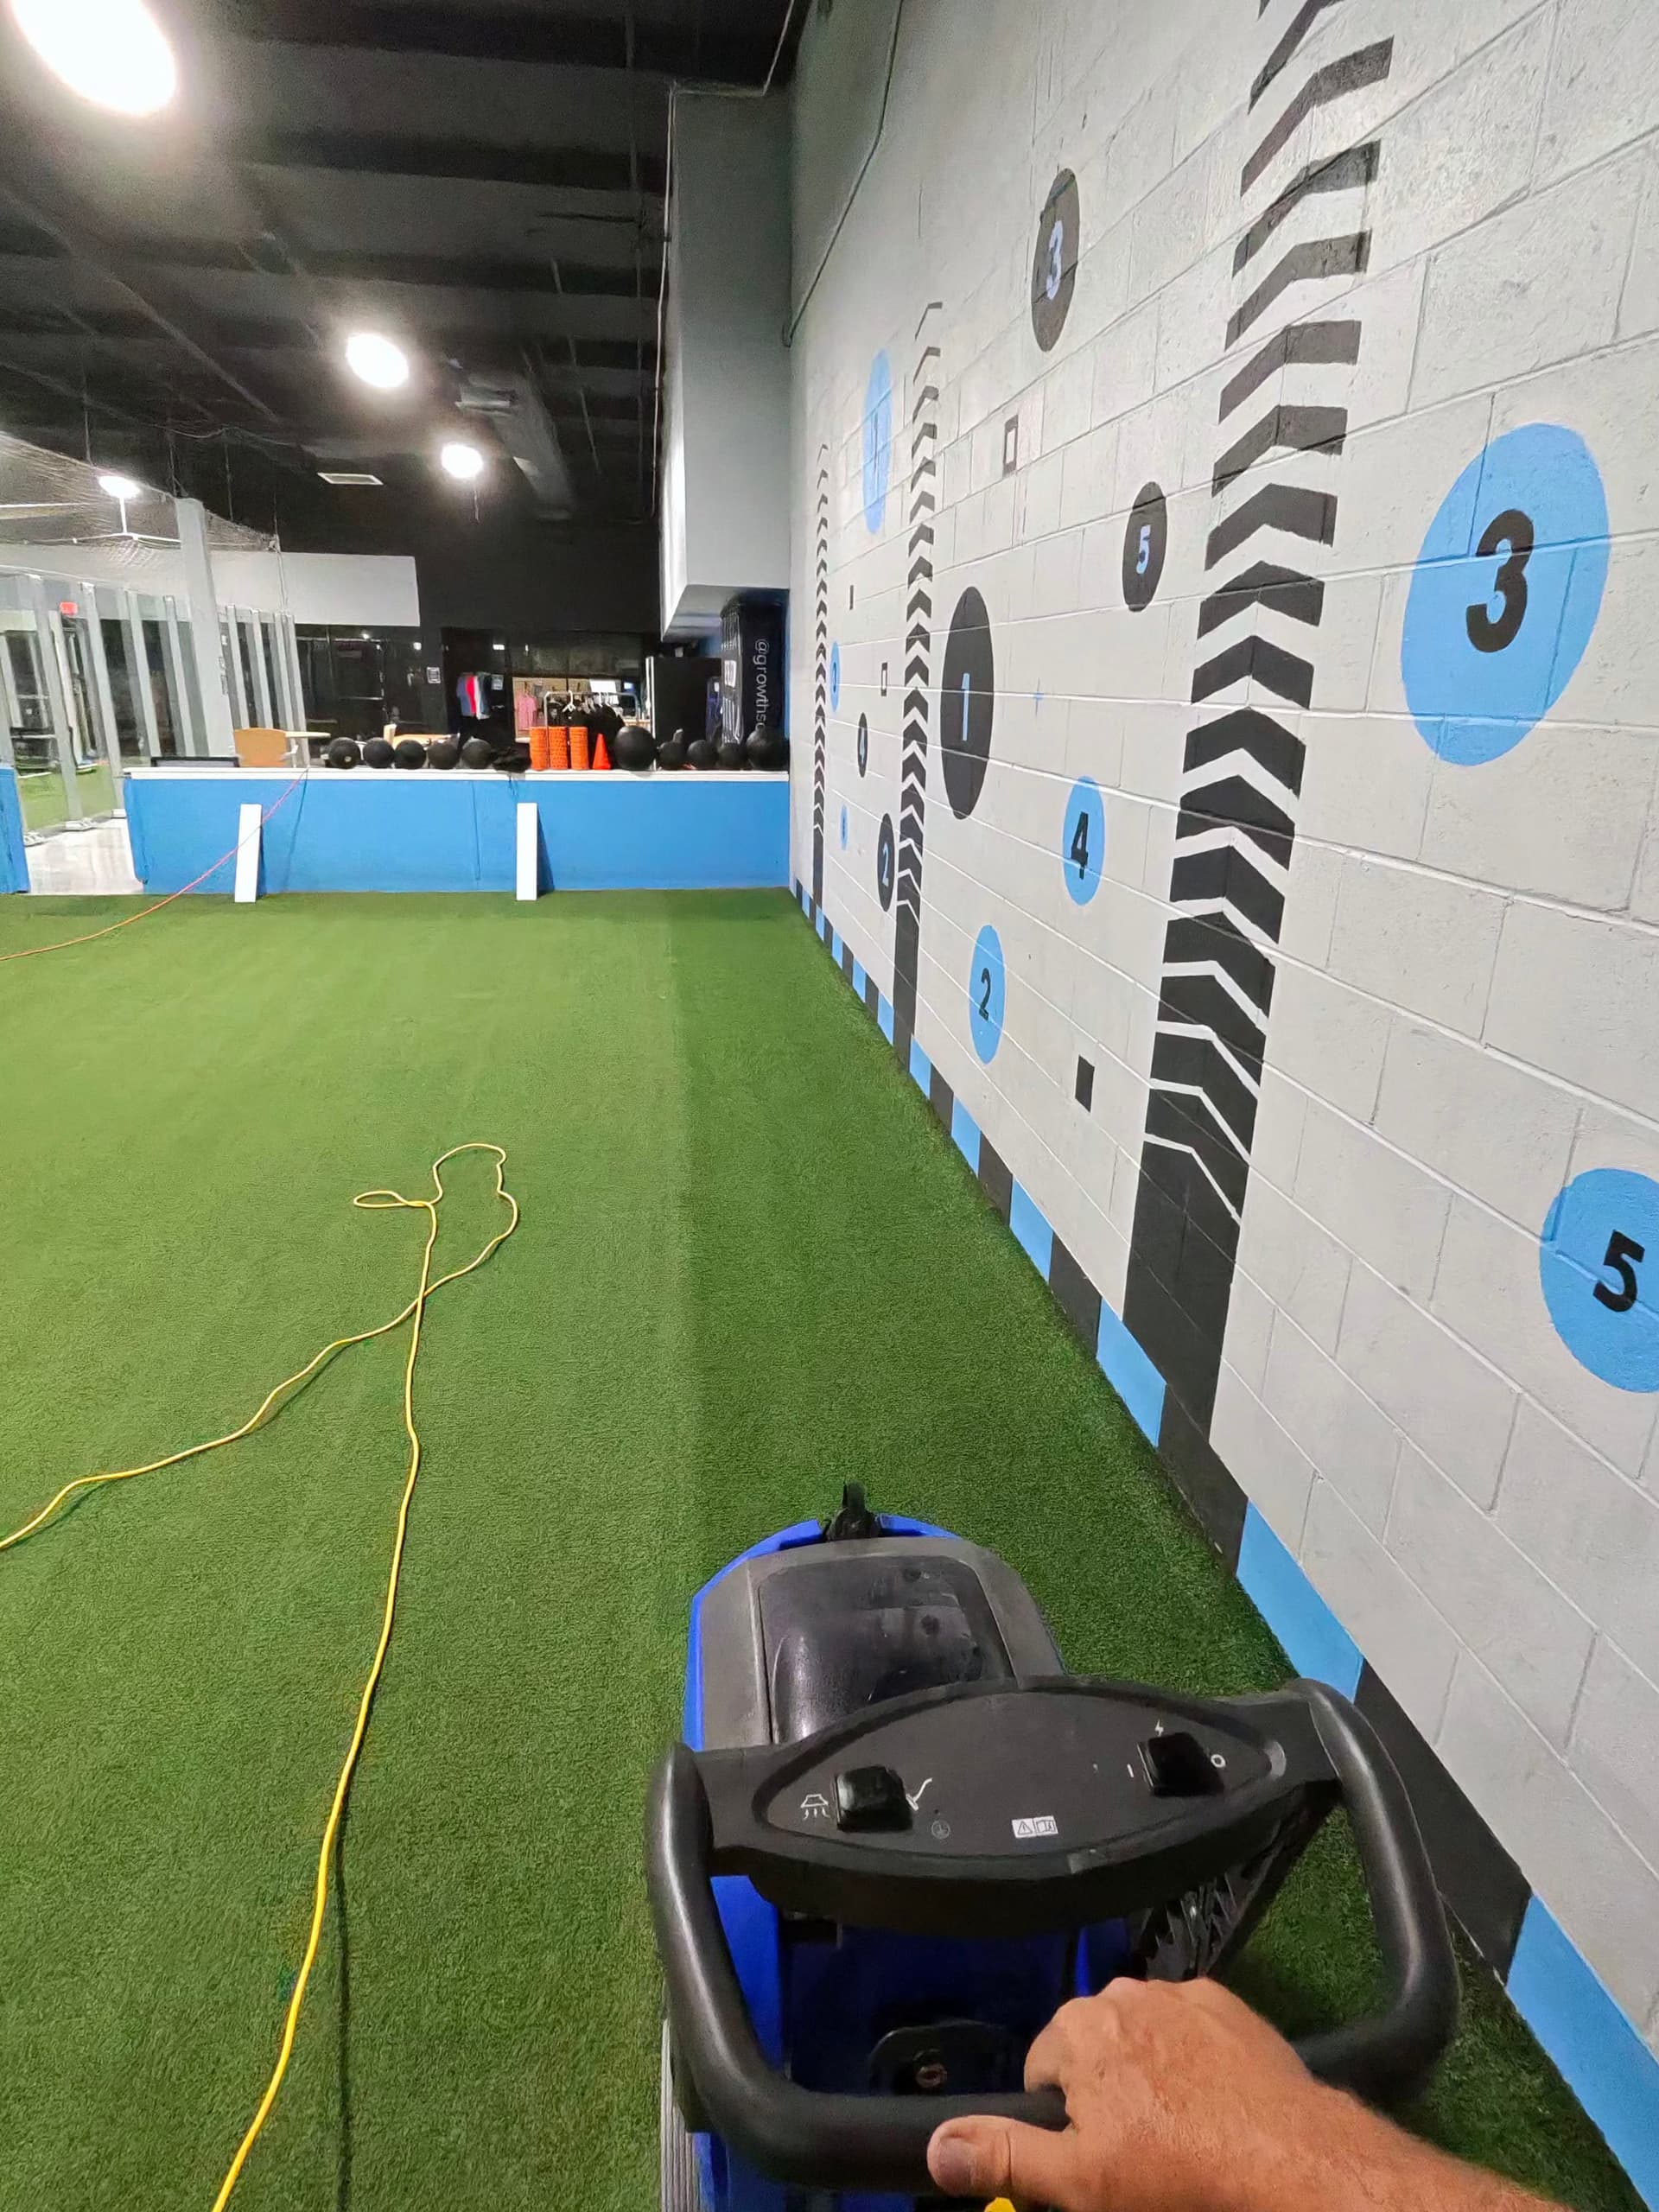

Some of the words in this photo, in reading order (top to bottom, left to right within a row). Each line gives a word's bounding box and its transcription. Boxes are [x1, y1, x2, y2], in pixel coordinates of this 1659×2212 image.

[1045, 219, 1063, 300] 3
[1135, 524, 1151, 575] 5
[1465, 509, 1532, 652] 3
[962, 672, 969, 741] 1
[882, 842, 889, 887] 2
[1071, 811, 1089, 879] 4
[979, 968, 990, 1021] 2
[1592, 1229, 1644, 1313] 5
